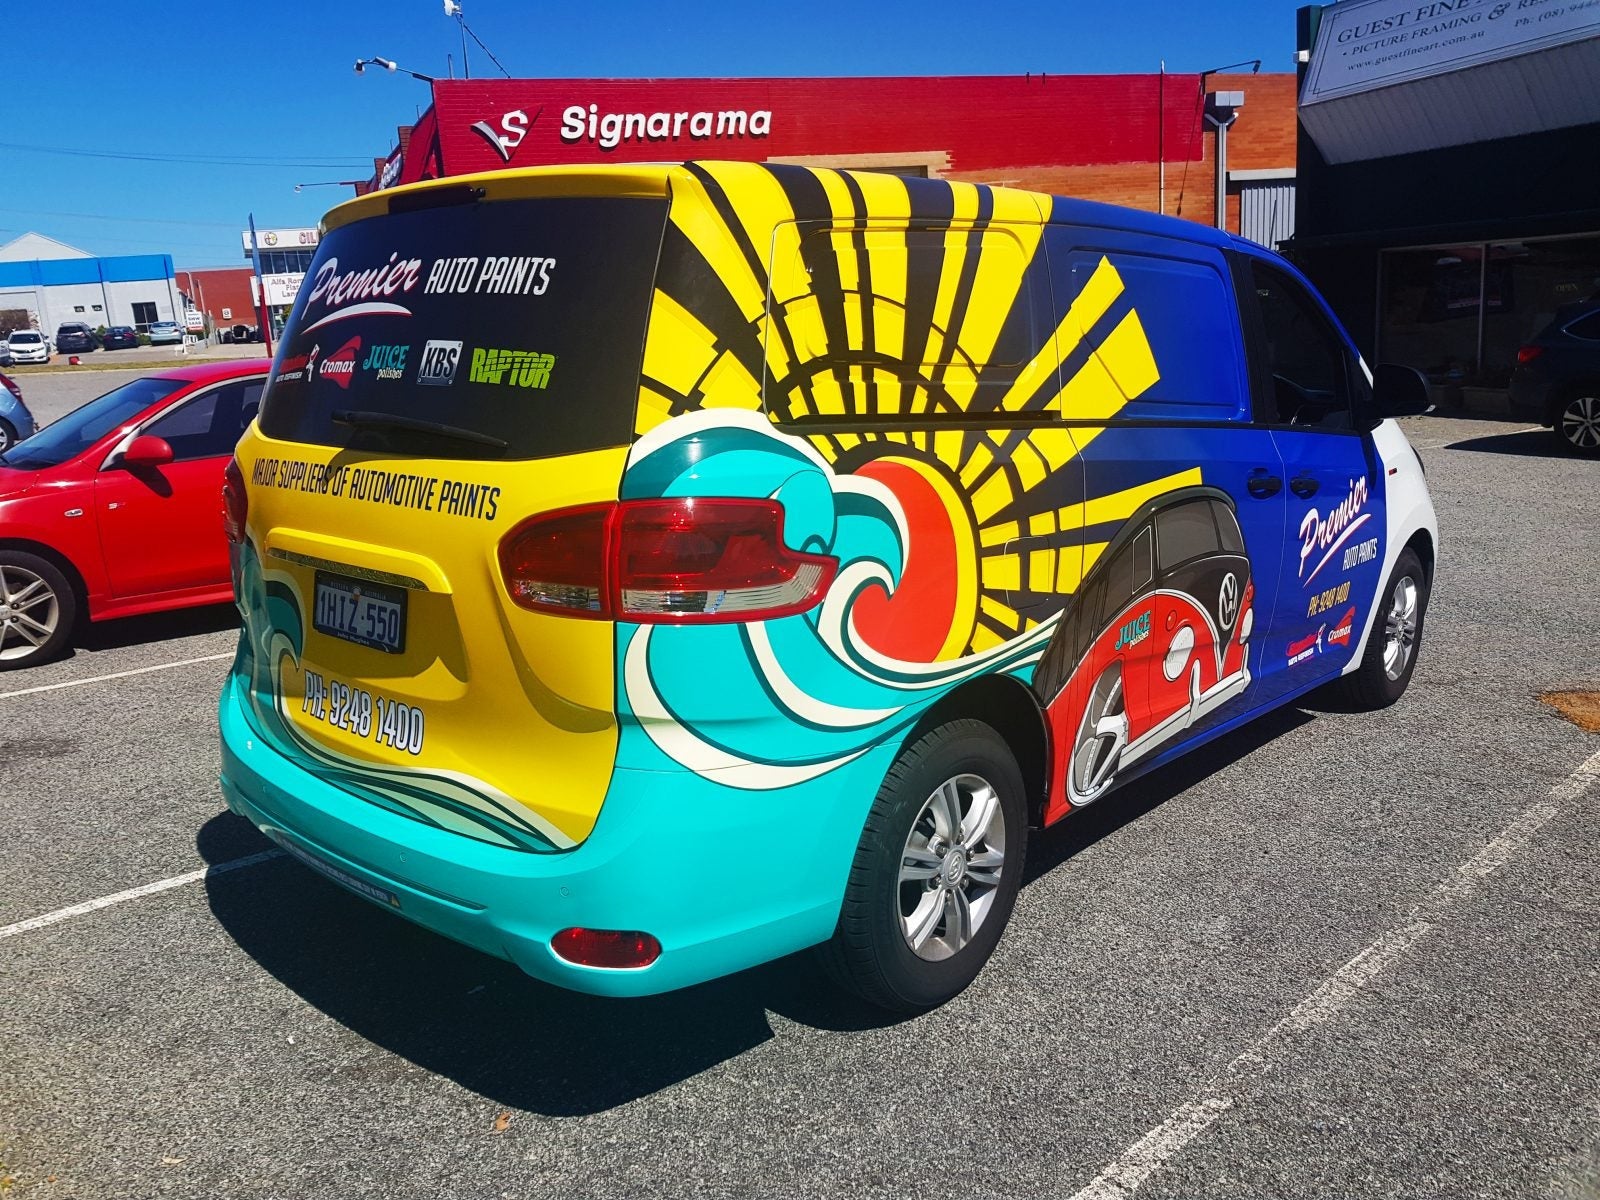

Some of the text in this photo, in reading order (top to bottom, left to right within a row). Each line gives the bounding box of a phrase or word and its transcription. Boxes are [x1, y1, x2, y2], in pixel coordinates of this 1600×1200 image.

[1337, 0, 1472, 43] GUEST FINE
[1352, 0, 1548, 56] PICTURE FRAMING & RE
[1514, 17, 1533, 28] Ph:
[1538, 8, 1565, 23] (08)
[1348, 30, 1485, 71] www.guestfineart.com.au
[560, 103, 772, 149] Signarama
[301, 251, 556, 321] Premier AUTO PAINTS
[319, 359, 356, 374] Cromax
[363, 345, 410, 370] JUICE
[376, 369, 403, 380] polishes
[420, 347, 458, 378] KBS
[469, 347, 556, 390] RAPTOR
[253, 458, 501, 521] MAJOR SUPPLIERS OF AUTOMOTIVE PAINTS
[1298, 475, 1368, 577] Premier
[1342, 537, 1378, 572] AUTO PAINTS
[1115, 610, 1152, 650] JUICE
[1327, 624, 1353, 642] Cromax
[302, 669, 424, 755] PH: 9248 1400
